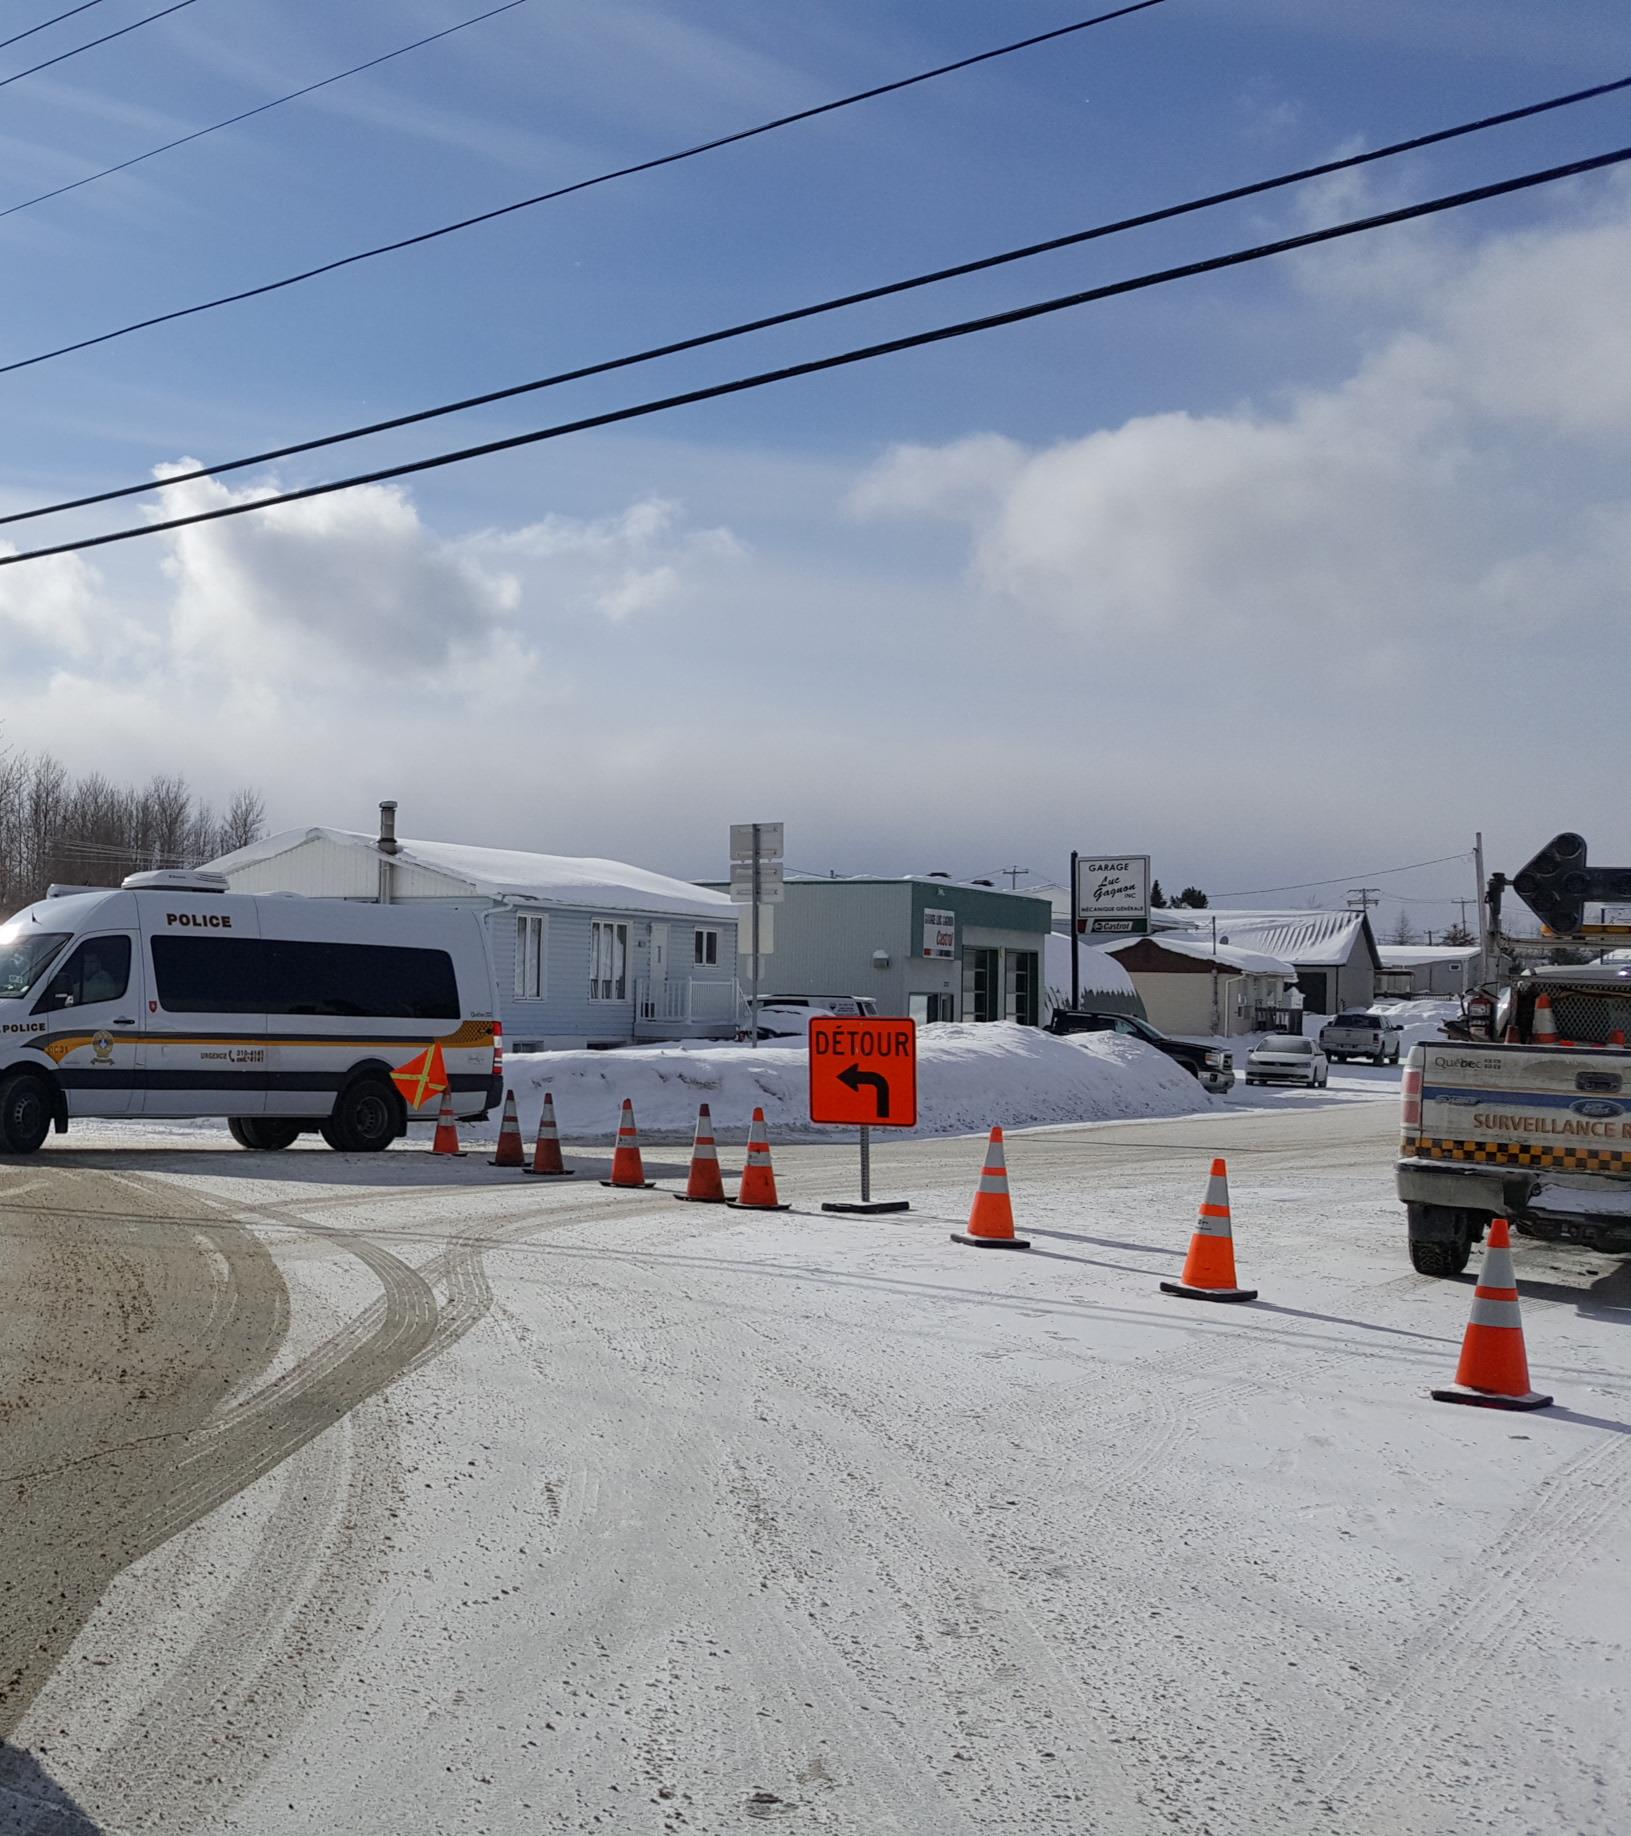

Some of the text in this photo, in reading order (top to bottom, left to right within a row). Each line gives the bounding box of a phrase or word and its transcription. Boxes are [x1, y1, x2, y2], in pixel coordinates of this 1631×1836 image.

[1088, 863, 1129, 872] GARAGE
[1098, 876, 1120, 888] Luc
[1093, 884, 1136, 902] Gagnon
[166, 913, 232, 928] POLICE
[1103, 922, 1129, 930] Castrol
[2, 1023, 46, 1033] POLICE
[815, 1025, 909, 1057] DÉTOUR
[1473, 1113, 1616, 1137] SURVEILLANCE
